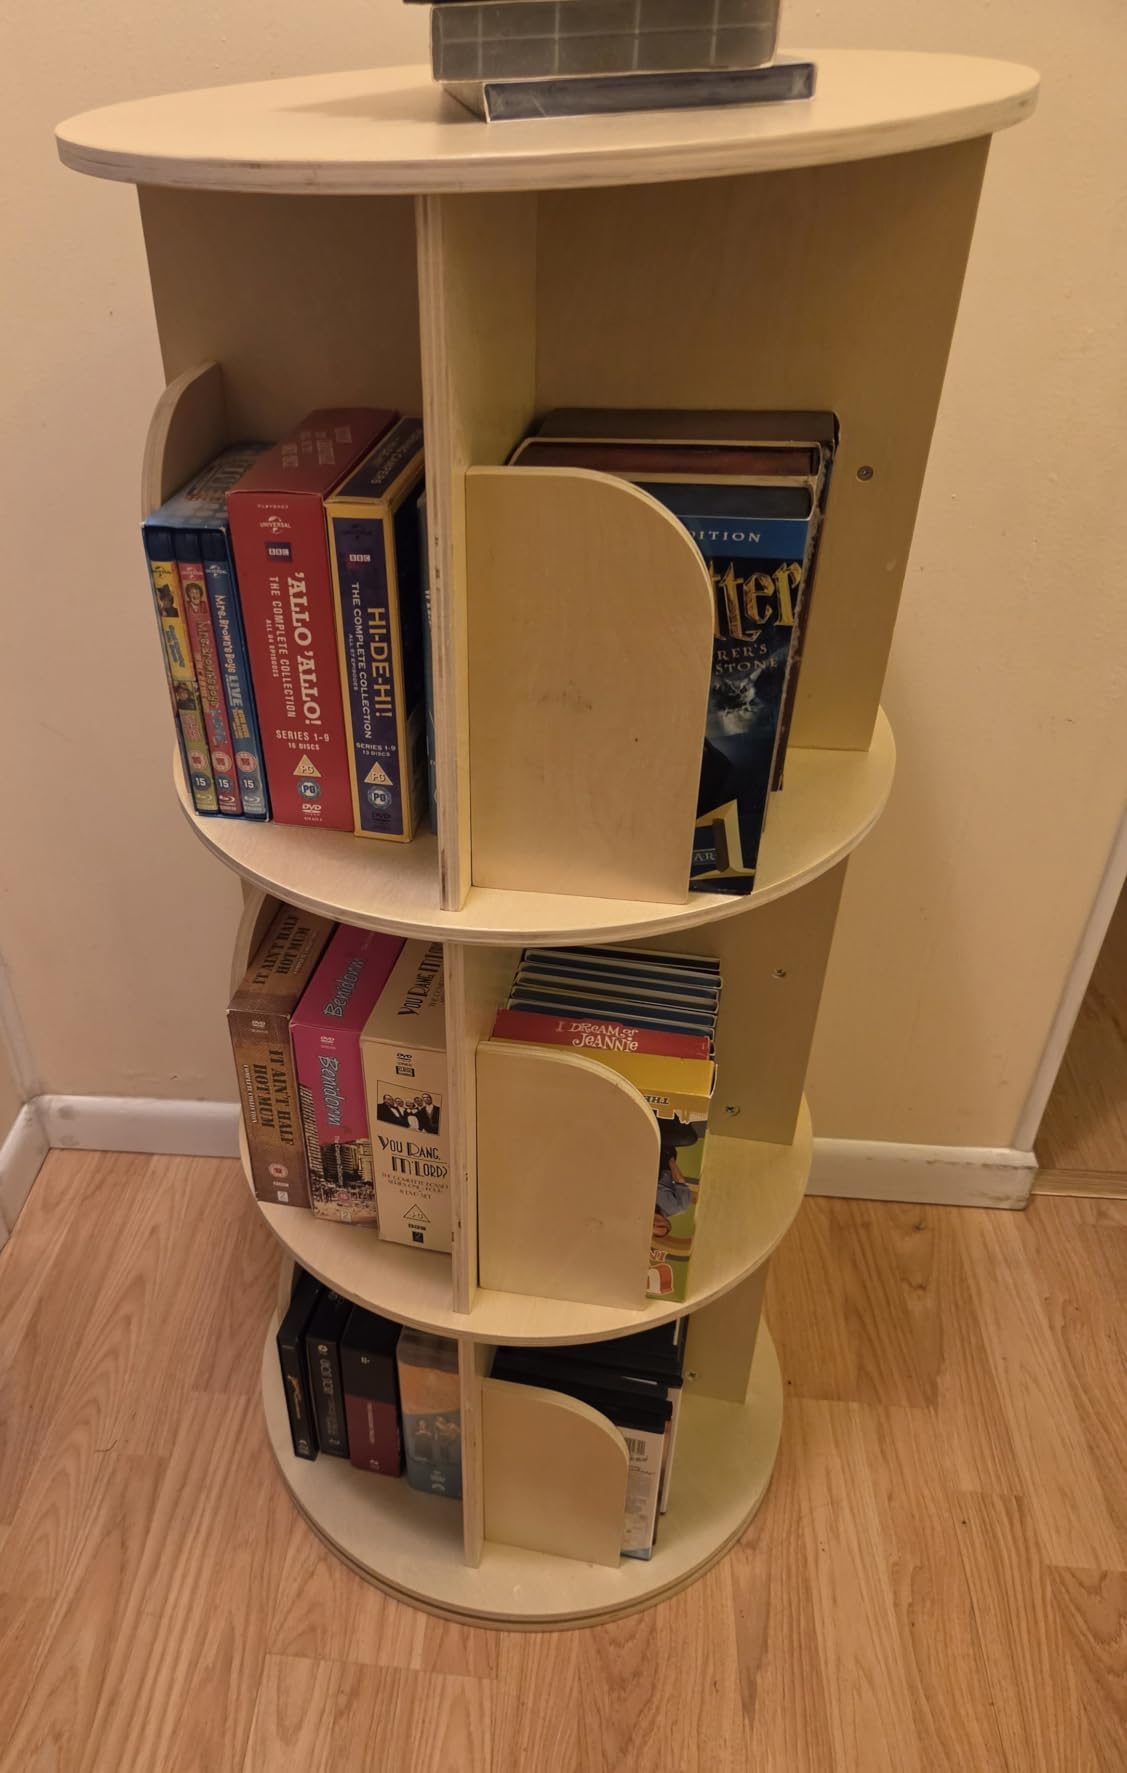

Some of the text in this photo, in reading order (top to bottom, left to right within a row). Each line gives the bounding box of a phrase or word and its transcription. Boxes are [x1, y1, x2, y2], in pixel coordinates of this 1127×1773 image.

[259, 520, 292, 529] UNIVERSAL
[268, 548, 290, 557] BBC
[349, 554, 371, 562] BBC
[214, 595, 227, 619] Mrs.
[219, 619, 234, 653] Brown's
[265, 619, 273, 632] ALL
[269, 645, 280, 678] EPISODES
[269, 576, 297, 718] THE COMPLETE COLLECTION
[225, 654, 237, 673] Boys
[351, 582, 373, 739] THE COMPLETE COLLECTION
[367, 607, 393, 718] HI-DE-HI!
[715, 657, 780, 674] STONE
[350, 659, 360, 691] EPISODES
[226, 674, 244, 707] LIVE
[275, 730, 330, 742] SERIES 1-9
[298, 742, 320, 751] DISCS
[356, 742, 383, 751] SERIES
[195, 777, 207, 787] 15
[218, 779, 230, 788] 15
[243, 780, 255, 789] 15
[302, 803, 322, 813] DVD
[286, 926, 311, 950] MUM
[275, 952, 299, 974] HOT
[322, 957, 364, 1017] Benidorm
[398, 996, 423, 1016] YOU
[555, 1021, 565, 1032] I
[269, 1049, 285, 1066] IT
[253, 1064, 276, 1128] HOT MUM
[271, 1069, 291, 1107] AIN'T
[318, 1055, 344, 1126] Benidorm
[277, 1110, 295, 1146] HALF
[378, 1135, 403, 1153] YOU
